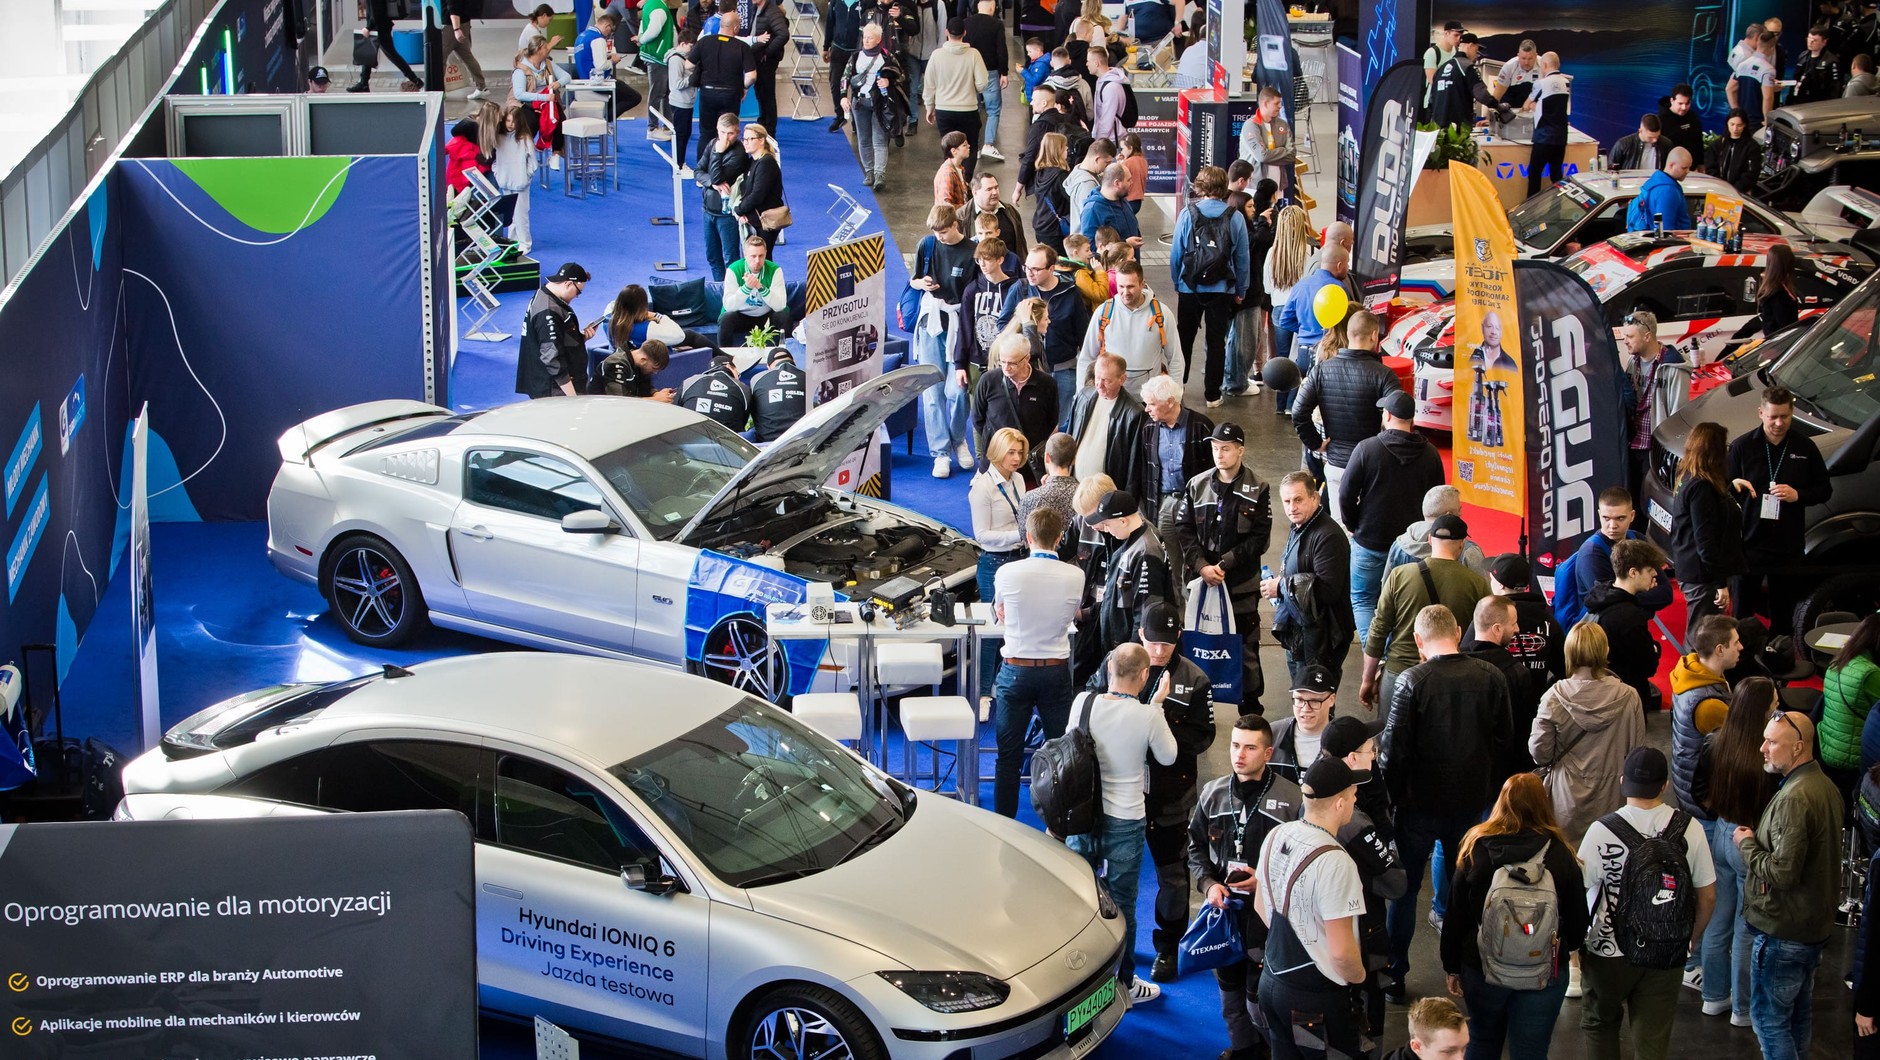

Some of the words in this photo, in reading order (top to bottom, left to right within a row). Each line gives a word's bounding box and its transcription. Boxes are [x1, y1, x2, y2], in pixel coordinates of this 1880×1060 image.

[1371, 99, 1402, 266] DUDA
[839, 271, 852, 280] TEXA
[1837, 270, 1859, 285] VORD
[822, 297, 869, 320] PRZYGOTUJ
[1192, 647, 1231, 660] TEXA
[1657, 889, 1675, 899] NIKE
[4, 897, 210, 926] Oprogramowanie
[217, 895, 251, 916] dla
[258, 891, 392, 918] motoryzacji
[519, 907, 597, 940] Hyundai
[602, 926, 658, 957] IONIQ
[663, 940, 676, 957] 6
[501, 927, 565, 959] Driving
[570, 943, 674, 982] Experience
[36, 971, 157, 988] Oprogramowanie
[160, 971, 185, 984] ERP
[188, 970, 210, 983] dla
[213, 967, 260, 983] branży
[262, 966, 343, 981] Automotive
[541, 961, 596, 988] Jazda
[601, 975, 674, 1006] testowa
[40, 1017, 102, 1034] Aplikacje
[105, 1015, 162, 1029] mobilne
[164, 1014, 186, 1028] dla
[188, 1011, 277, 1026] mechaników
[279, 1011, 284, 1023] i
[287, 1009, 361, 1024] kierowców
[1070, 1006, 1083, 1031] PY
